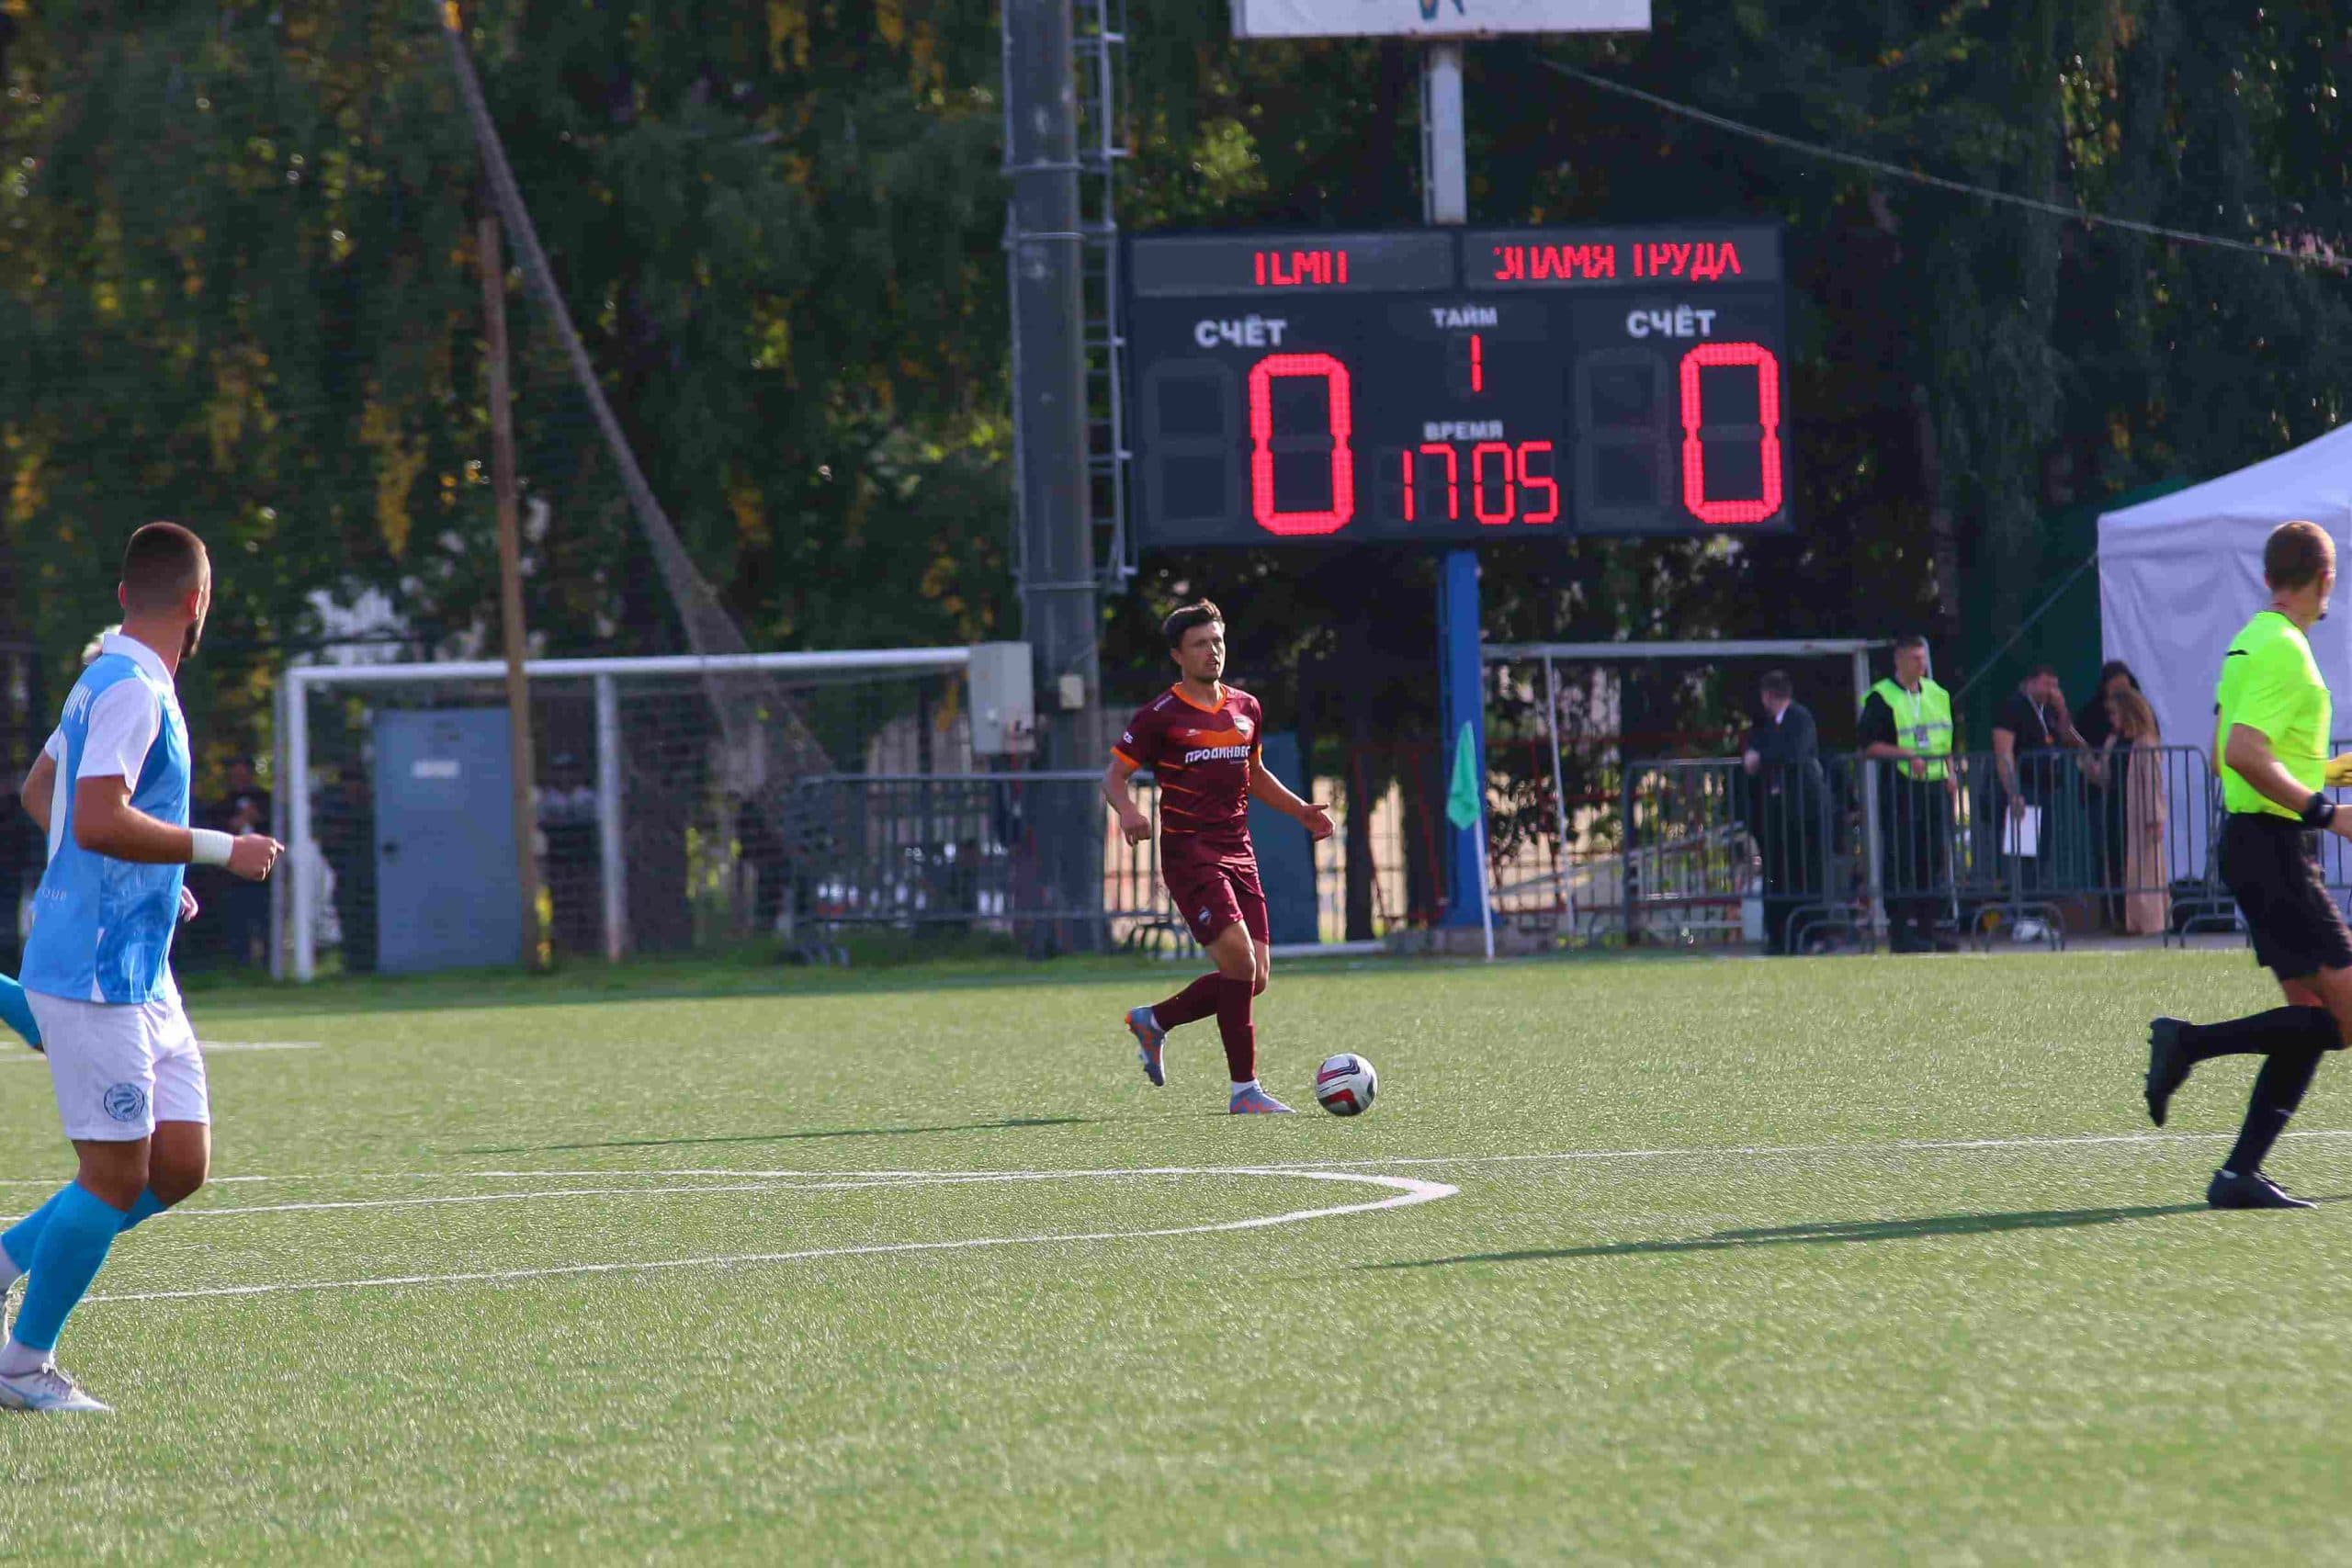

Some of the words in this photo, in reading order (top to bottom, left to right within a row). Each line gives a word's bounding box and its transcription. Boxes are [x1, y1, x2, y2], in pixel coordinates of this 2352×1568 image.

[1430, 302, 1498, 328] ТАЙМ
[1626, 305, 1717, 339] СЧЁТ
[1194, 317, 1288, 348] СЧЁТ
[1248, 353, 1356, 536] 0
[1424, 420, 1504, 442] ВРЕМЯ
[1679, 342, 1784, 525] 0
